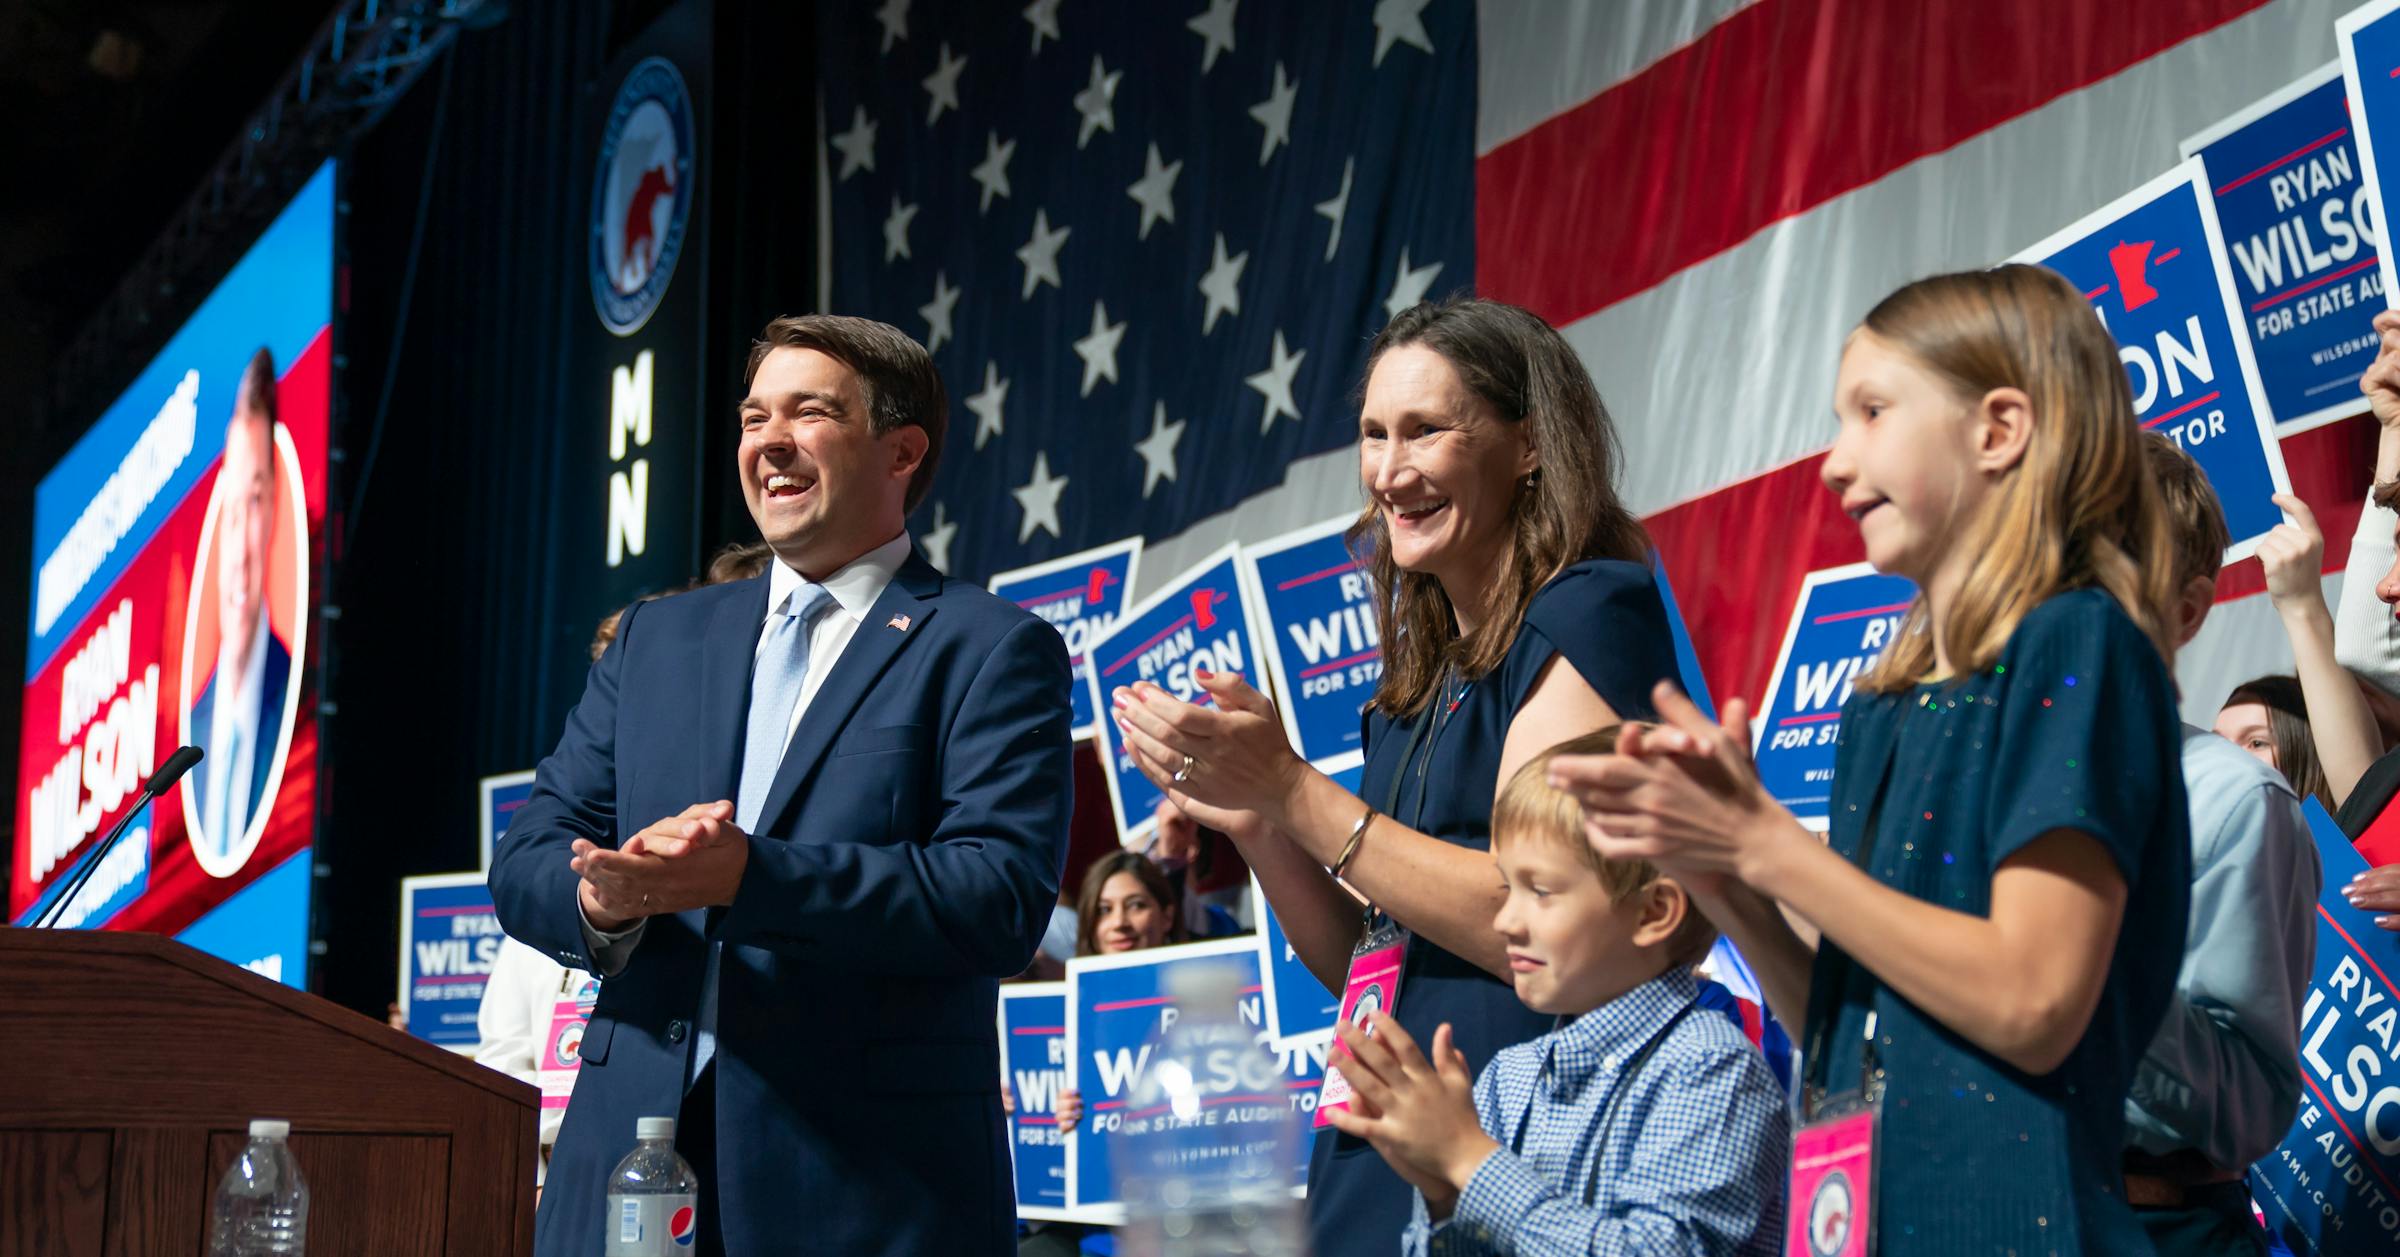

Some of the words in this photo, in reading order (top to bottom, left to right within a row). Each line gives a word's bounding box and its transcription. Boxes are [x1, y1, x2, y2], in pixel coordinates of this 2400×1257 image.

[2269, 145, 2354, 213] RYAN
[2256, 308, 2295, 340] FOR
[2296, 283, 2356, 326] STATE
[2163, 408, 2227, 450] TOR
[1136, 627, 1196, 681] RYAN
[1302, 671, 1345, 700] FOR
[1770, 728, 1815, 751] FOR
[30, 664, 160, 883] WILSON
[415, 937, 505, 976] WILS
[1153, 1108, 1218, 1132] STATE
[2275, 1141, 2345, 1232] 4MN.COM
[2315, 1129, 2400, 1242] AUDITO
